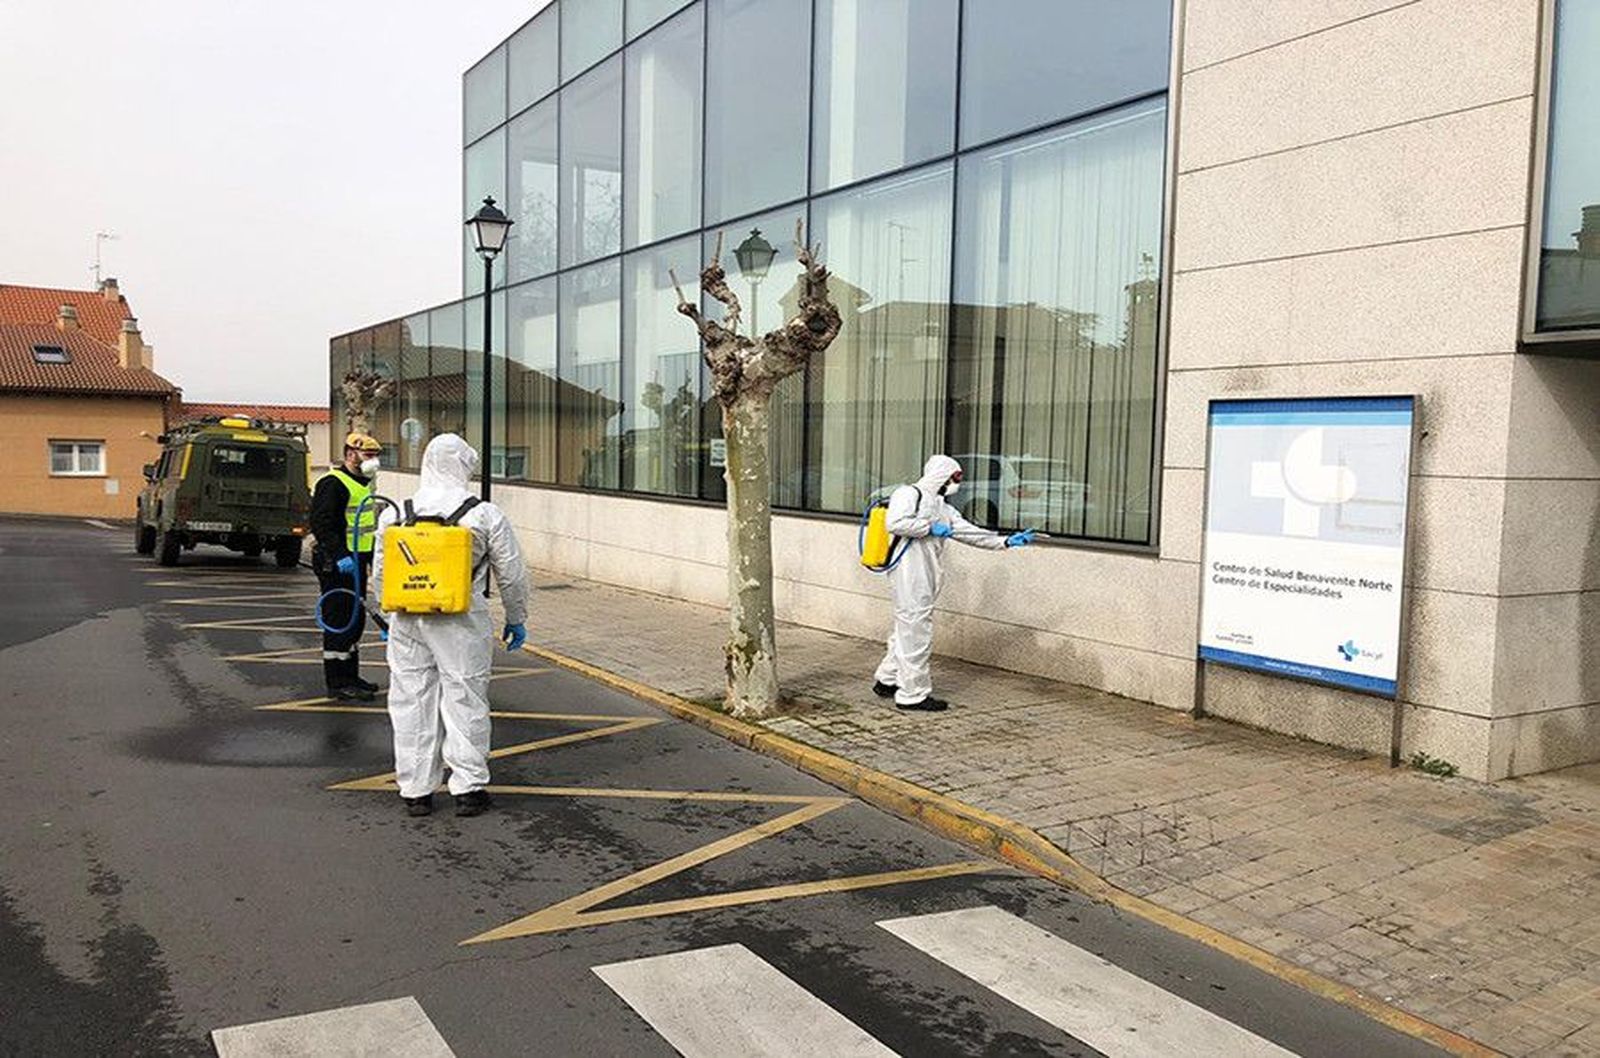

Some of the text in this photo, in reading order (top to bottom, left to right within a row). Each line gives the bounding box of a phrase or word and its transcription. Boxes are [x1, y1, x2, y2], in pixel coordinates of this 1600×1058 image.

[1212, 574, 1343, 599] Centro de Especialidades
[1213, 562, 1393, 592] Centro de Salud Benavente Norte
